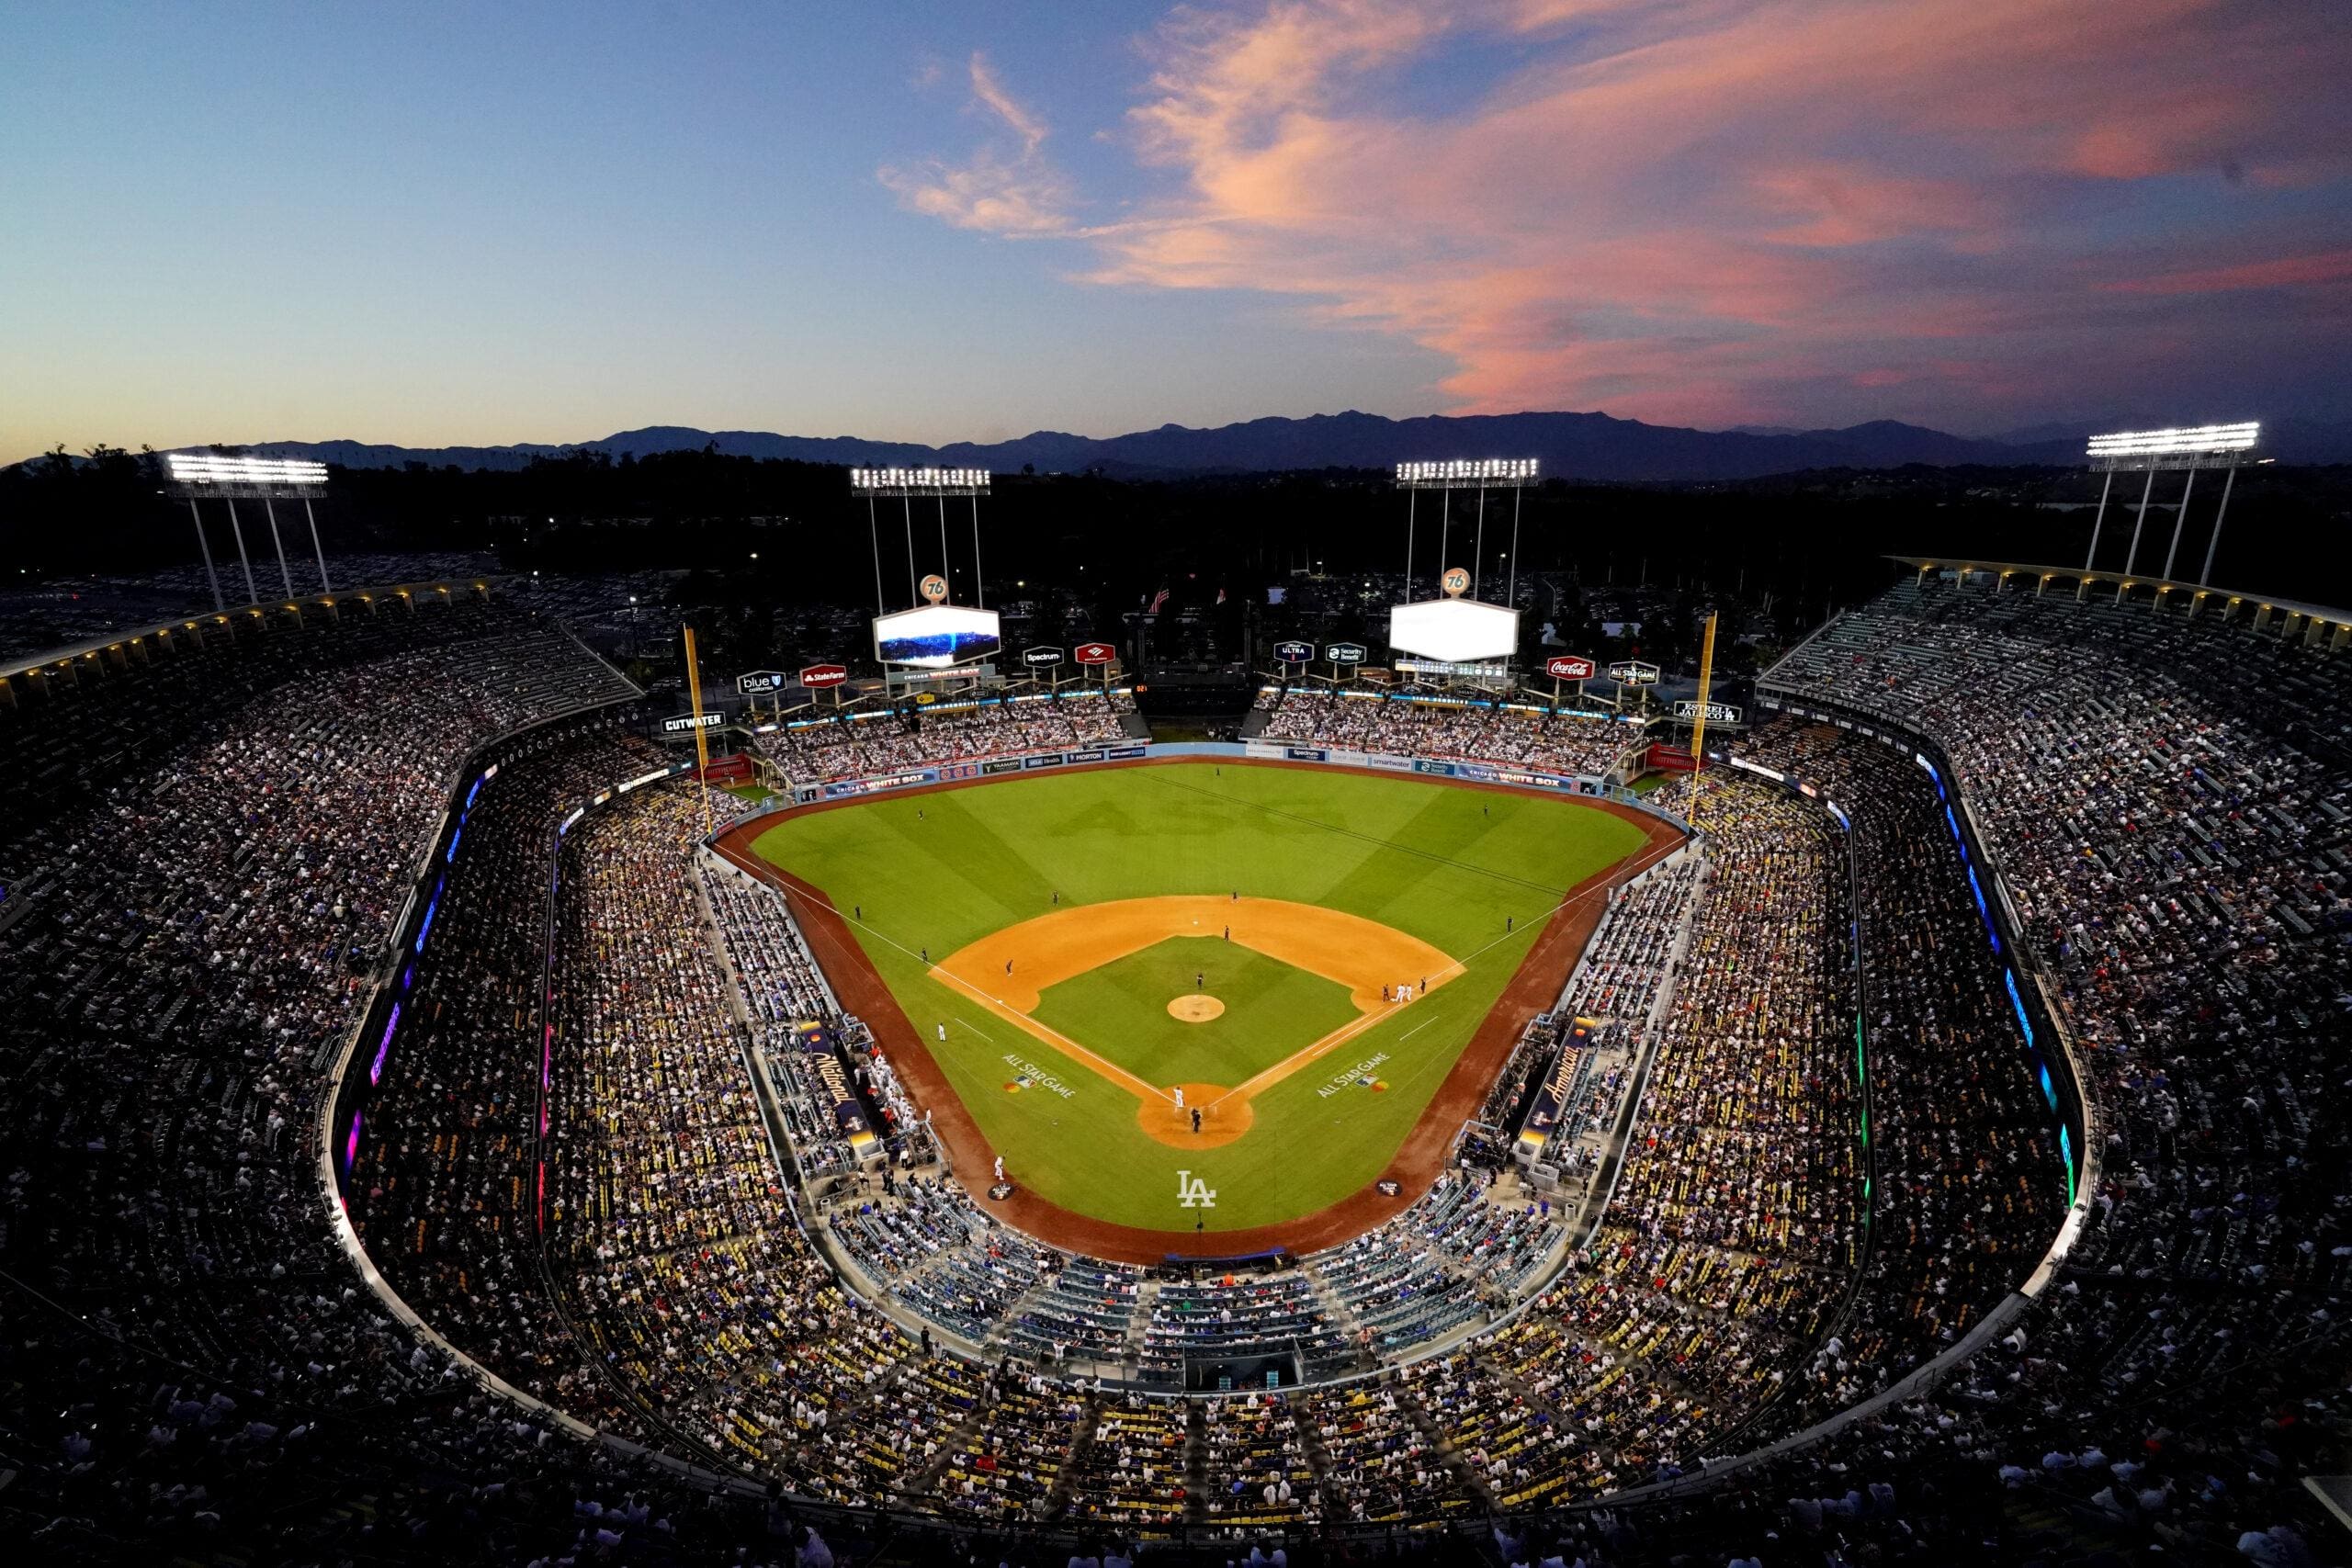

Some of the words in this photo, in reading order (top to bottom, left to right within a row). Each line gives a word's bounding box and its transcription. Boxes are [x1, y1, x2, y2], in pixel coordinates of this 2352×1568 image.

[928, 581, 944, 594] 76
[1447, 574, 1464, 588] 76
[1027, 653, 1059, 661] Spectrum
[929, 670, 959, 679] WHITE
[960, 668, 979, 676] SOX
[1637, 671, 1656, 679] GAME
[743, 677, 770, 688] blue
[1679, 709, 1722, 719] JALISCO
[665, 715, 721, 731] CUTWATER
[1374, 759, 1409, 768] smartwater
[837, 784, 865, 793] CHICAGO
[866, 778, 900, 789] WHITE
[902, 773, 924, 784] SOX
[1470, 770, 1498, 778] CHICAGO
[1498, 773, 1533, 784] WHITE
[1534, 777, 1560, 787] SOX
[814, 1053, 857, 1106] National
[1001, 1055, 1023, 1066] ALL
[1019, 1064, 1046, 1081] STAR
[1042, 1077, 1076, 1099] GAME
[1317, 1084, 1340, 1098] ALL
[1333, 1069, 1363, 1087] STAR
[1357, 1052, 1390, 1072] GAME
[1544, 1045, 1584, 1104] American
[1176, 1170, 1216, 1208] LA
